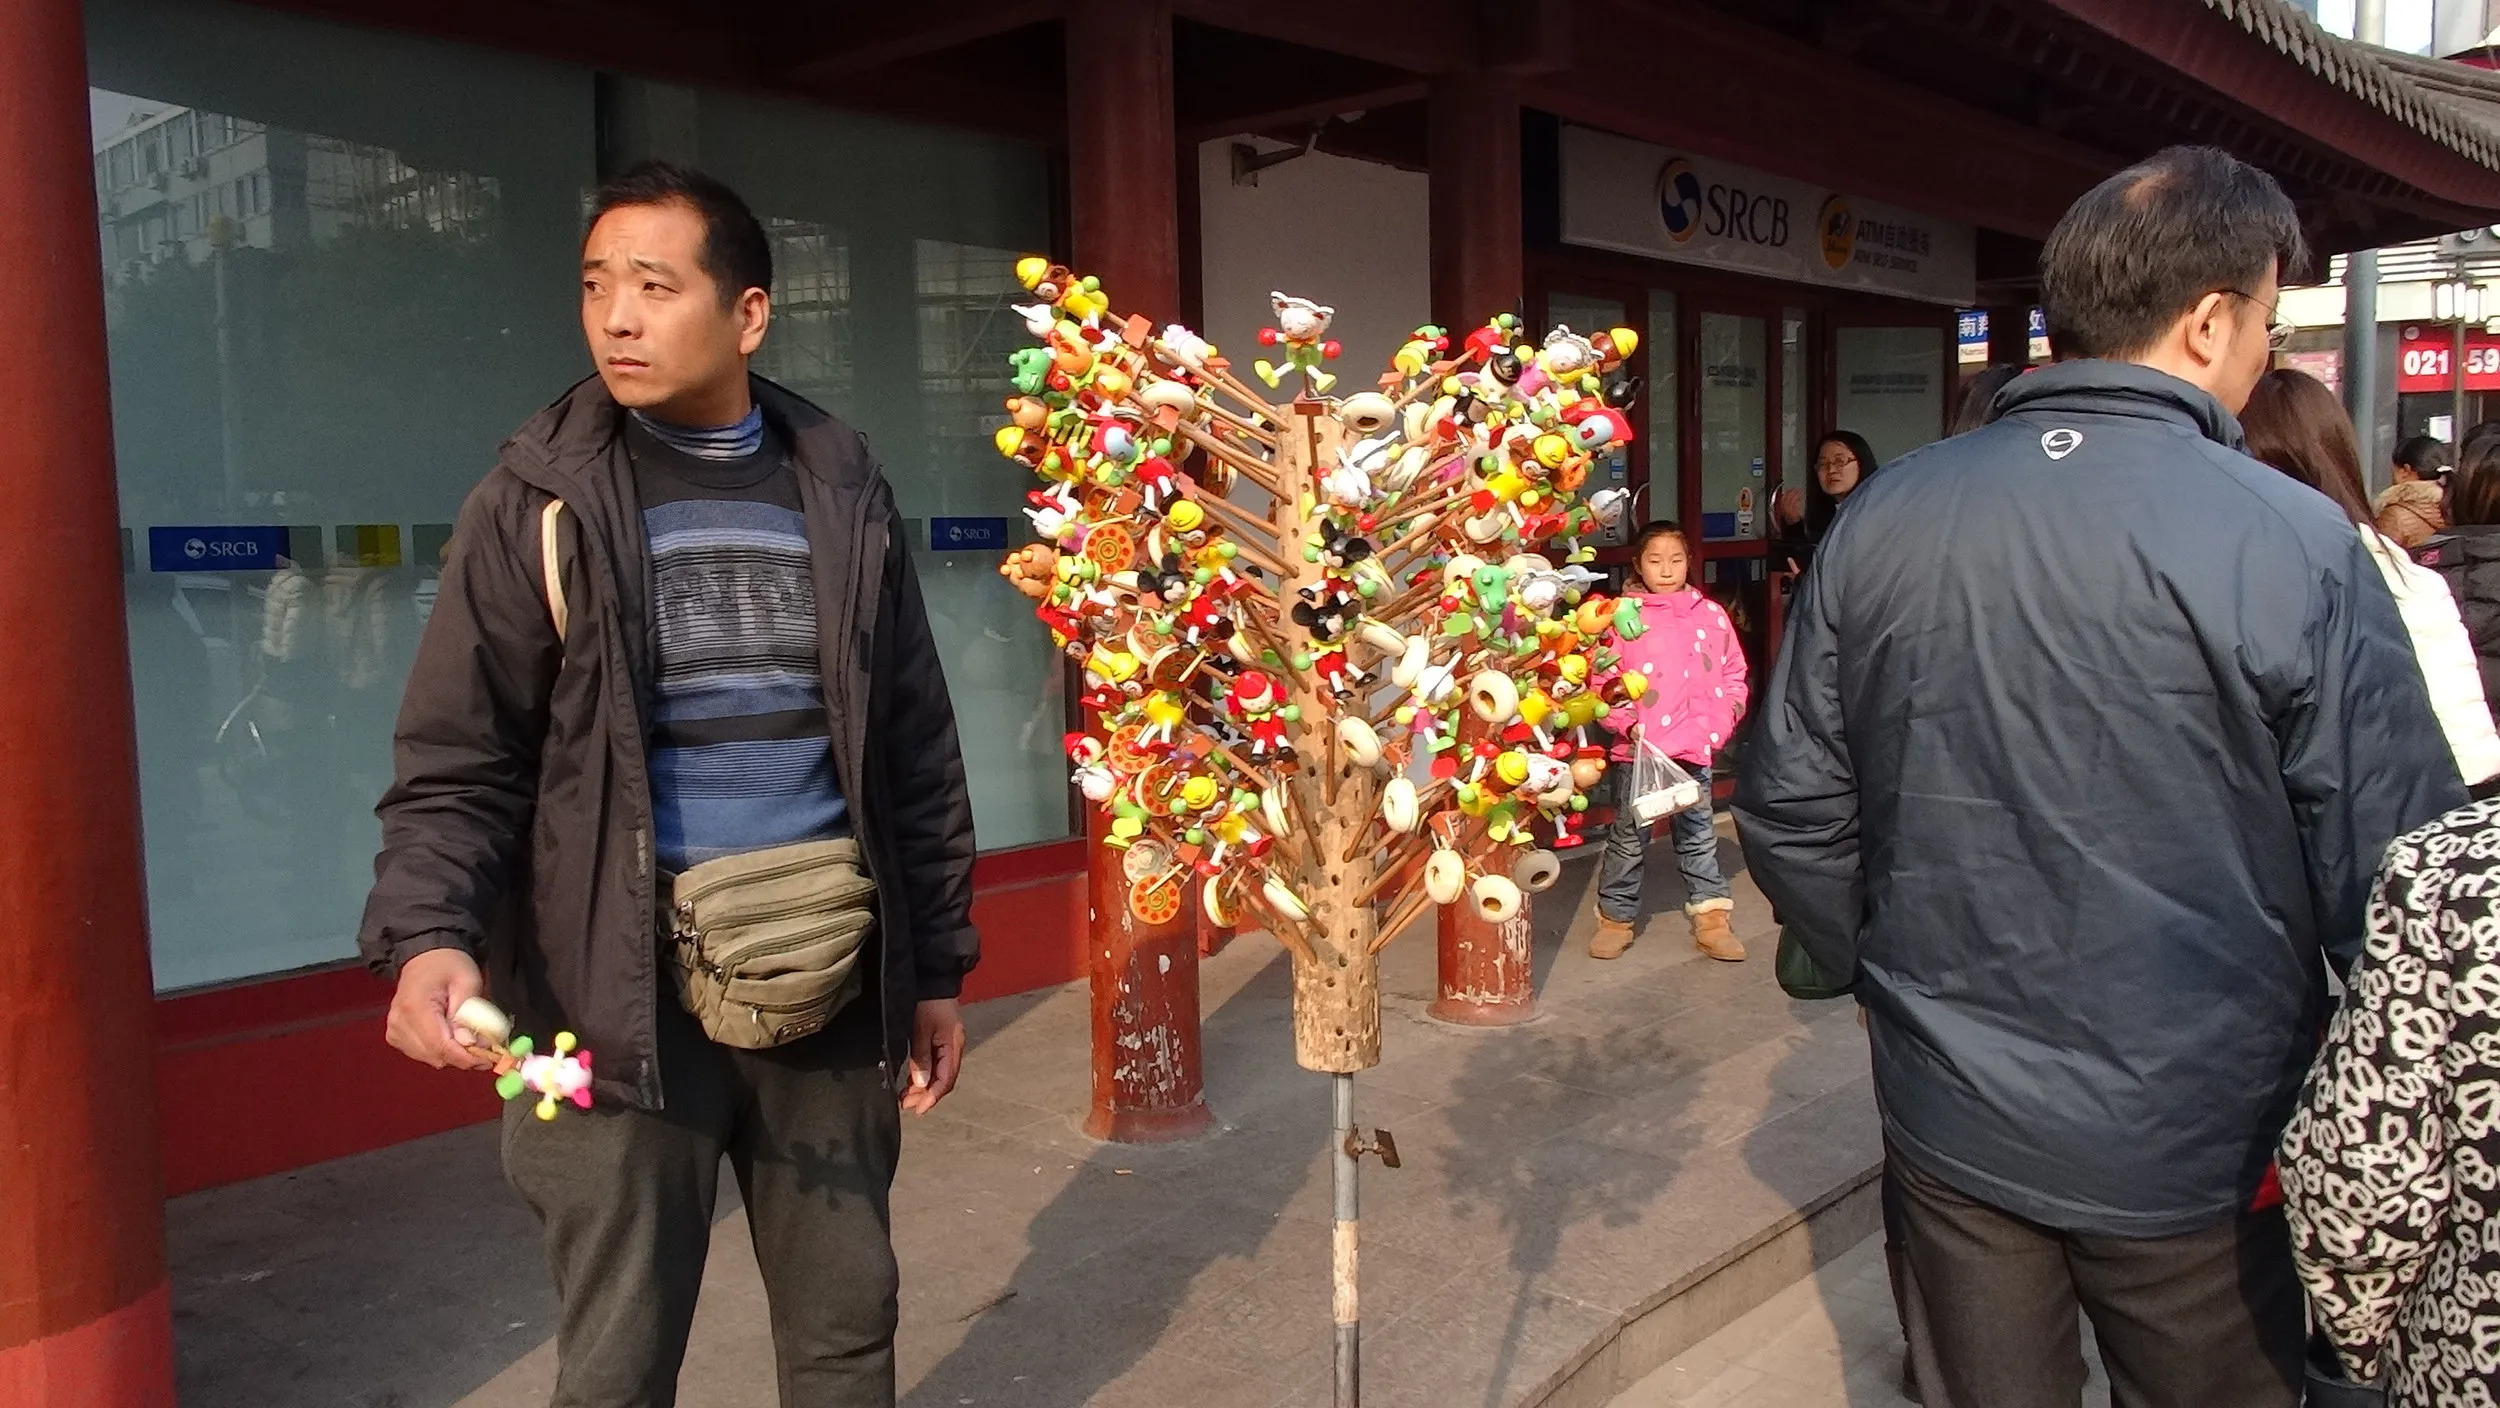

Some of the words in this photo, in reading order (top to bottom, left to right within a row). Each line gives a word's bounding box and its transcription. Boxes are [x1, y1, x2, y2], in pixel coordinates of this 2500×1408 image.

[1705, 183, 1790, 247] SRCB
[2403, 349, 2449, 376] 021
[963, 528, 991, 540] SRCB
[209, 541, 258, 556] SRCB
